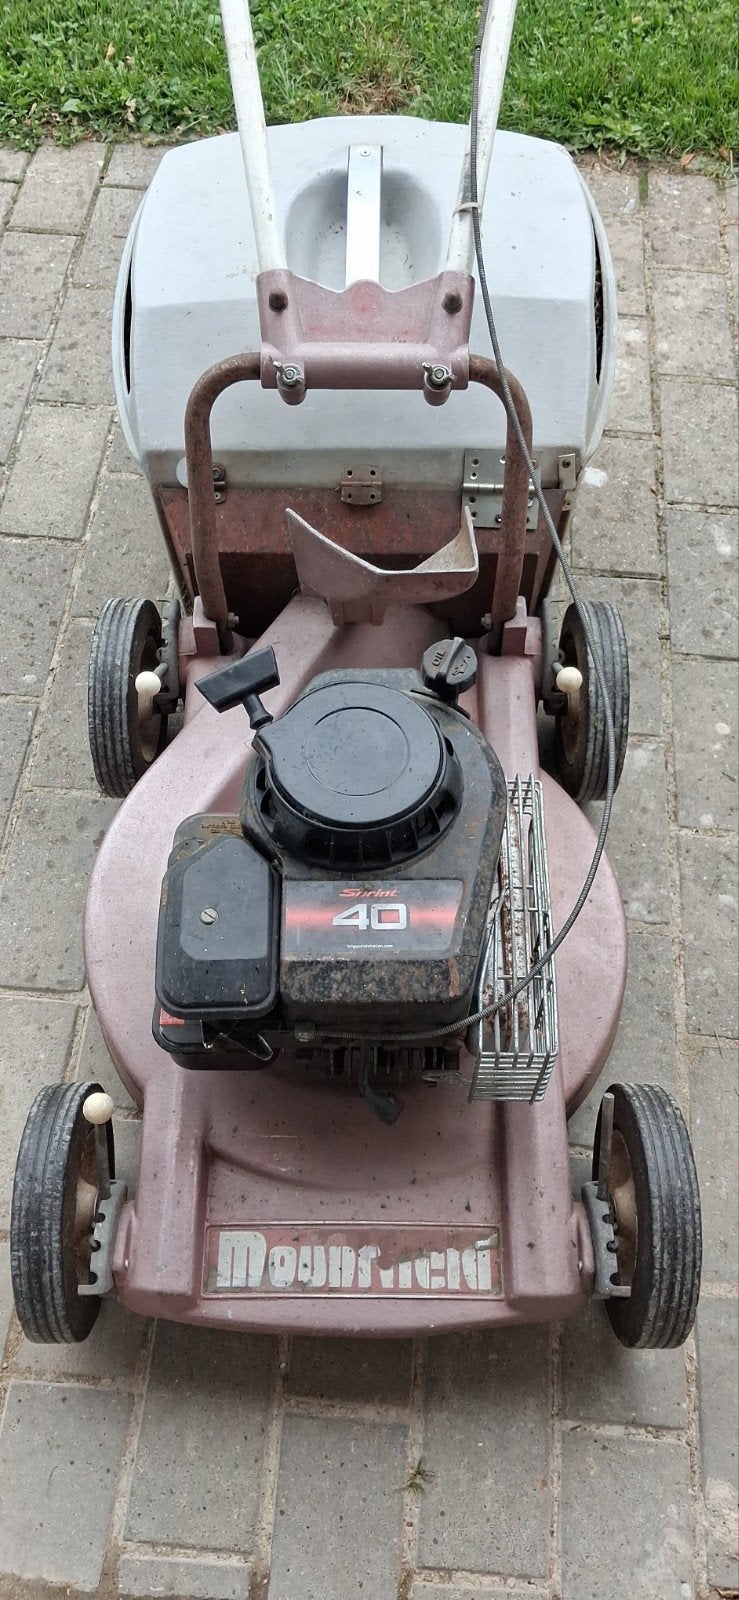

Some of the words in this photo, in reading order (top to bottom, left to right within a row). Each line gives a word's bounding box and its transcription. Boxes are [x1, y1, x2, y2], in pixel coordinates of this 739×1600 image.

[431, 651, 446, 667] OIL
[339, 888, 398, 898] Sprint
[332, 903, 408, 930] 40
